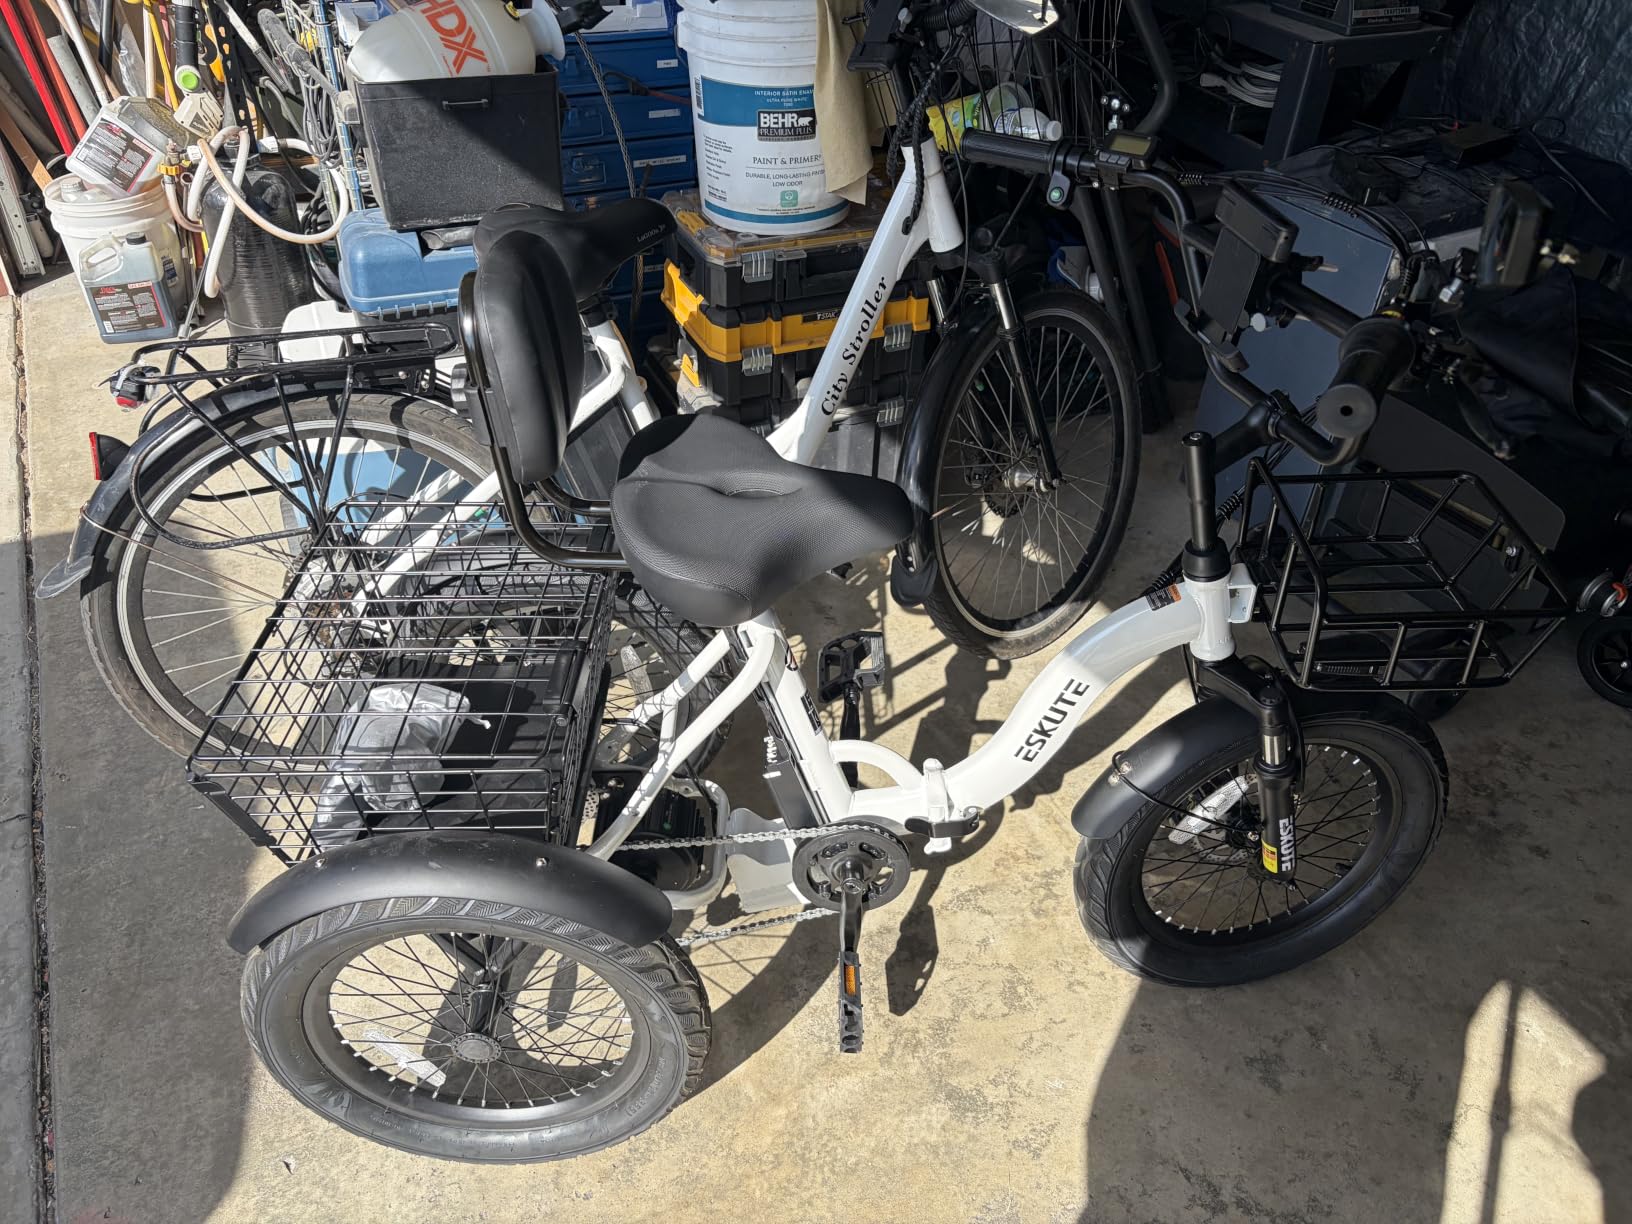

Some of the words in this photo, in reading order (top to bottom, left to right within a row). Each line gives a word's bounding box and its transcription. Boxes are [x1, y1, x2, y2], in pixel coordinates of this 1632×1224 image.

[416, 0, 489, 75] HDX
[759, 112, 798, 128] BEHR
[759, 128, 794, 136] PREMIUM
[795, 127, 813, 135] PLUS
[745, 172, 771, 180] DURABLE,
[752, 156, 779, 165] PAINT
[780, 157, 787, 165] &
[821, 372, 848, 416] City
[842, 276, 888, 365] Stroller
[1013, 678, 1090, 762] ESKUTE
[1279, 815, 1296, 872] ESKUTE
